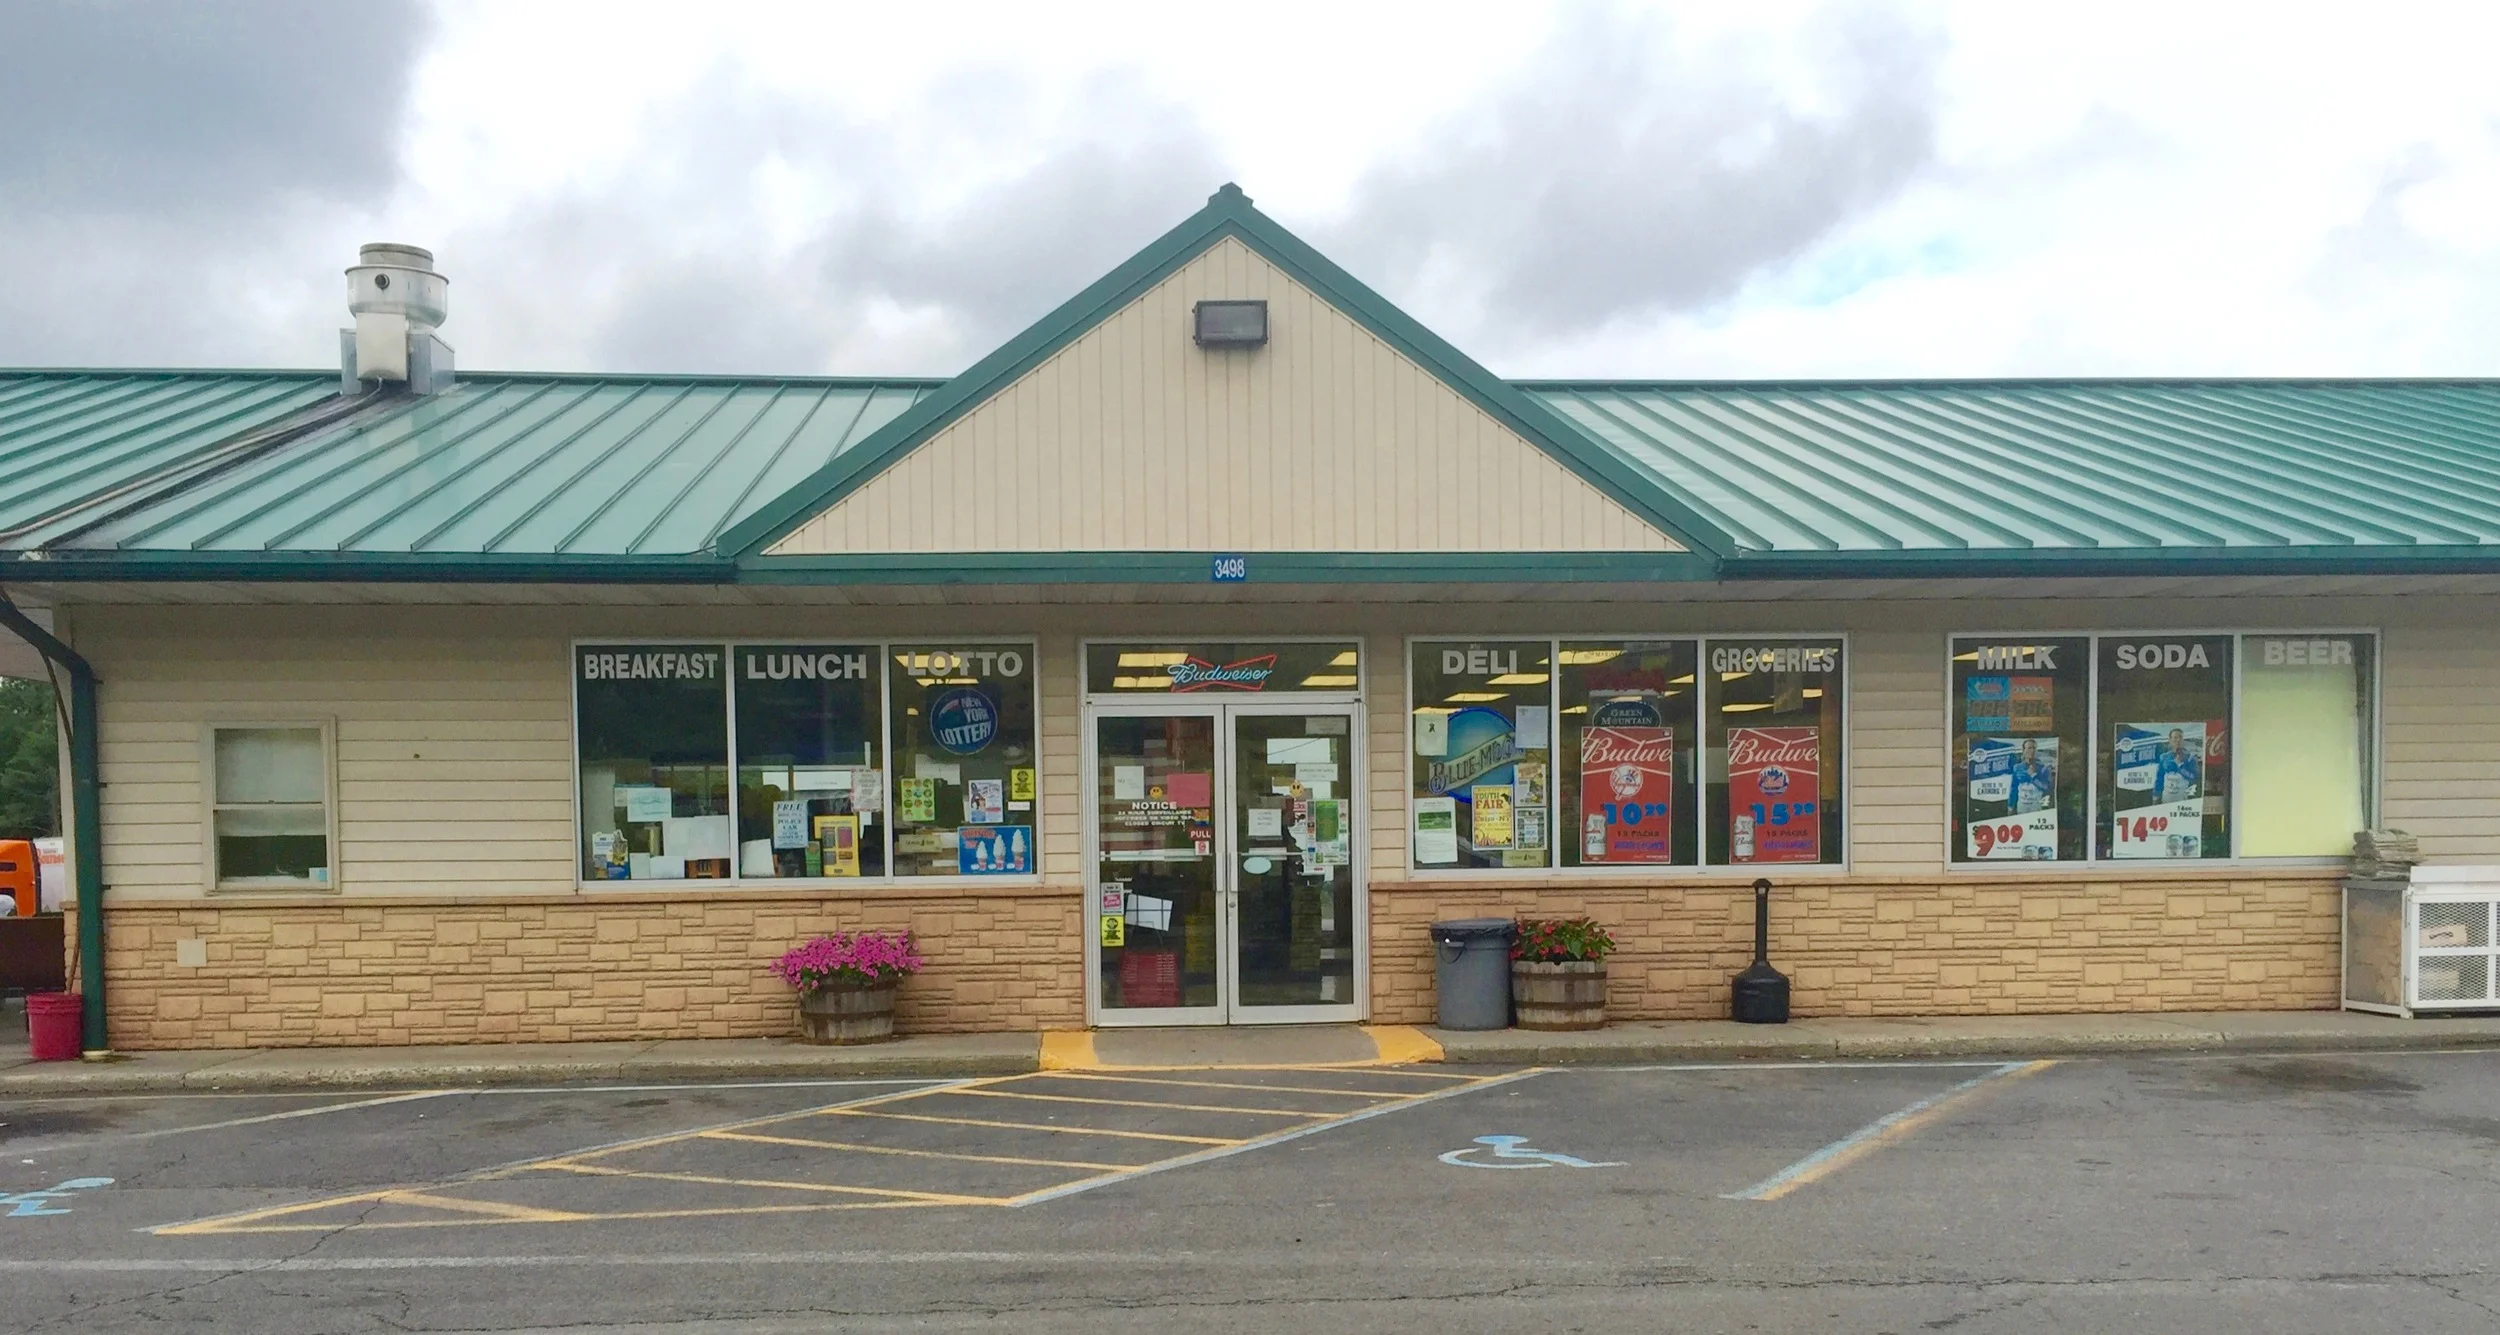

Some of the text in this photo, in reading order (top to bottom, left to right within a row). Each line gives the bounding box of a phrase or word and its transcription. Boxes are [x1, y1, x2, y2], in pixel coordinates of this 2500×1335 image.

[1215, 559, 1245, 578] 3498
[1442, 650, 1518, 674] DELI
[1712, 647, 1835, 673] GROCERIES
[1978, 646, 2059, 670] MILK
[2116, 644, 2210, 669] SODA
[2264, 641, 2352, 665] BEER
[584, 653, 718, 679] BREAKFAST
[747, 654, 867, 679] LUNCH
[907, 651, 1023, 677] LOTTO
[1167, 663, 1272, 683] Budweiser
[961, 696, 983, 708] NEW
[963, 707, 990, 723] YORK
[1601, 717, 1652, 726] MOUNTAIN
[1611, 709, 1643, 717] GREEN
[940, 721, 992, 746] LOTTERY
[1132, 801, 1177, 810] NOTICE
[1475, 792, 1500, 800] YOUTH
[1475, 799, 1504, 809] FAIR
[776, 803, 803, 811] FREE
[1190, 830, 1211, 838] PULL
